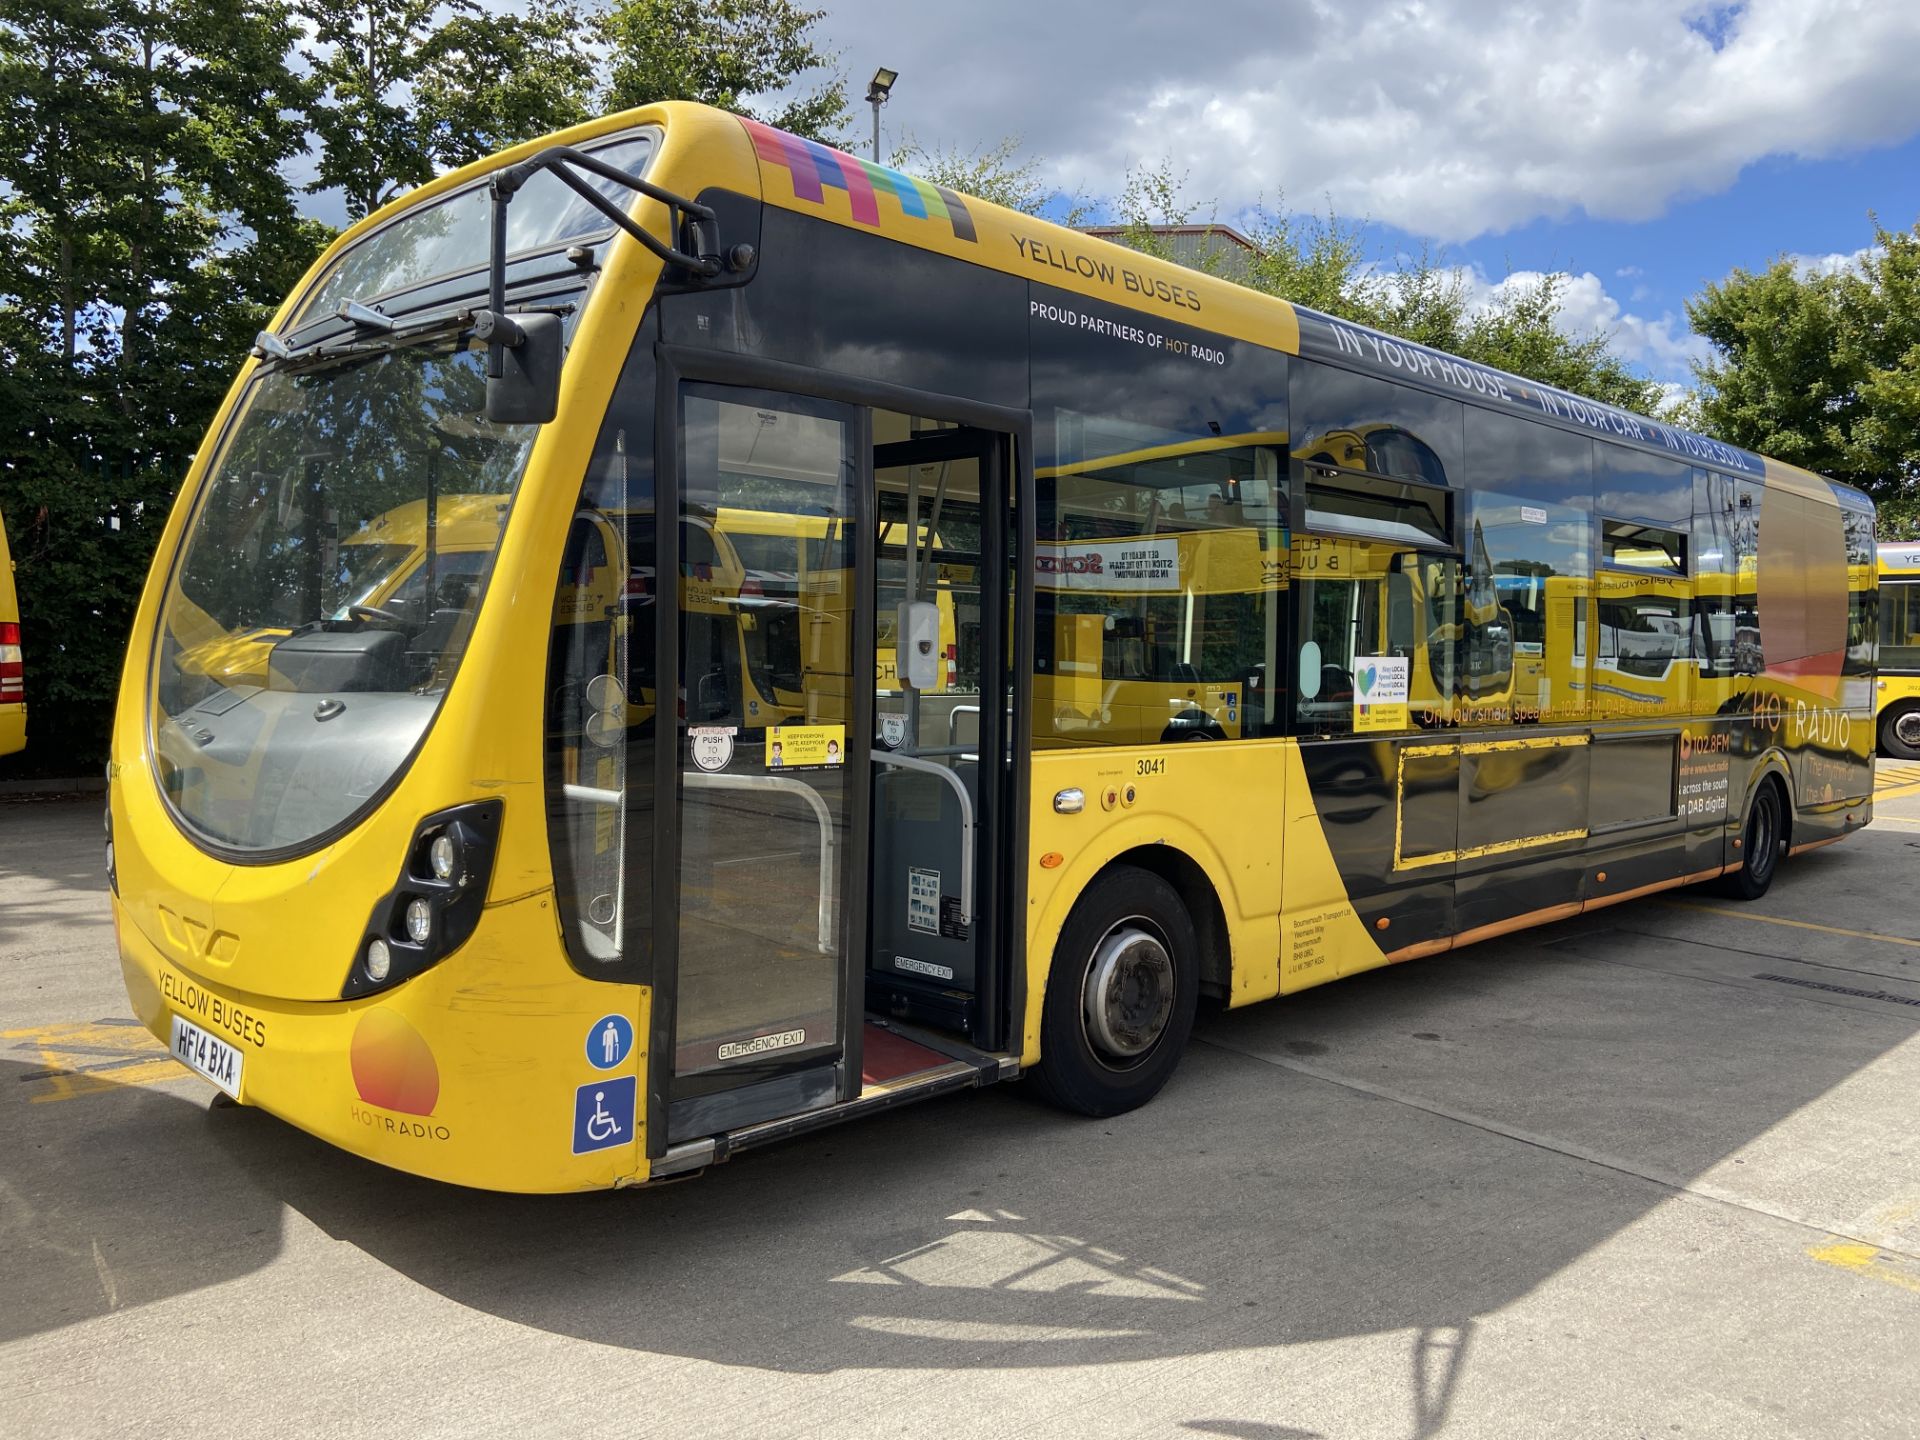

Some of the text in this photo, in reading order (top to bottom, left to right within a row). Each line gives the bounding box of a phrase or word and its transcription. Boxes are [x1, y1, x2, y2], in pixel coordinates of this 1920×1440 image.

[1010, 233, 1201, 312] YELLOW BUSES
[1030, 301, 1225, 366] PROUD PARTNERS OF HOT RADIO
[1330, 322, 1749, 471] IN YOUR HOUSE IN YOUR CAR IN YOUR SOUL
[1424, 704, 1442, 724] On
[1477, 704, 1511, 721] smart
[708, 746, 718, 754] TO
[1692, 733, 1730, 755] 102.8FM
[1137, 758, 1165, 776] 3041
[1683, 782, 1702, 794] across
[1702, 779, 1712, 791] the
[1712, 777, 1728, 789] south
[1688, 798, 1704, 815] DAB
[1705, 794, 1728, 813] digital
[896, 957, 952, 978] EMERGENCY EXIT
[159, 969, 266, 1048] YELLOW BUSES
[178, 1023, 234, 1086] HF14 BXA
[720, 1031, 803, 1058] EMERGENCY EXIT
